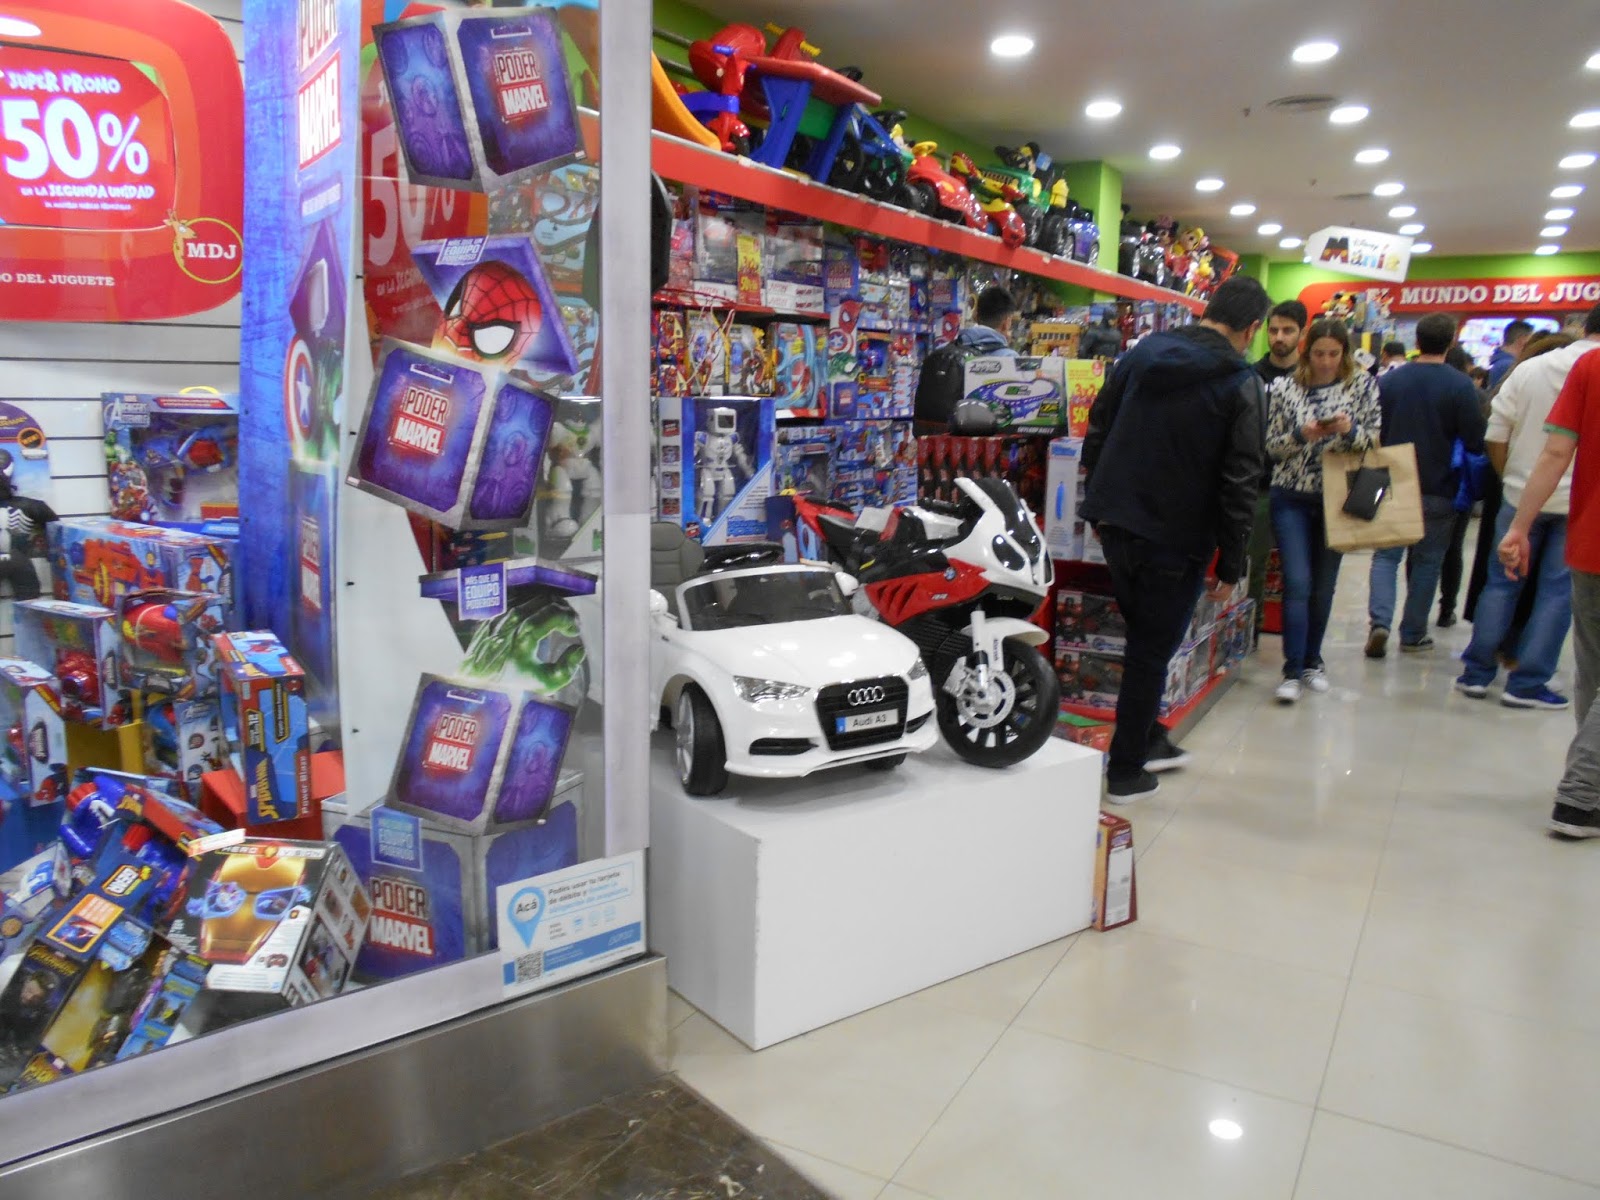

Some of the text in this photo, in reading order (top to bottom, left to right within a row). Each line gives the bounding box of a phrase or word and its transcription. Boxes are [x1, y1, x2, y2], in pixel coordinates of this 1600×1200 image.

[496, 52, 539, 83] PODER
[8, 70, 121, 94] SUPER PROMO
[299, 58, 341, 165] MARVEL
[502, 84, 547, 115] MARVEL
[2, 98, 149, 180] 50%
[35, 187, 48, 197] LA
[48, 184, 108, 198] SEGUNDA
[108, 185, 155, 199] UNIDAD
[187, 243, 236, 260] MDJ
[445, 245, 480, 255] EQUIPO
[0, 273, 115, 286] O DEL JUGUETE
[1400, 285, 1487, 304] MUNDO
[1492, 283, 1545, 303] DEL
[1549, 282, 1600, 302] JUG
[404, 388, 448, 424] PODER
[394, 416, 442, 454] MARVEL
[465, 582, 500, 599] EQUIPO
[439, 715, 477, 744] PODER
[852, 714, 887, 727] Audi A3
[428, 742, 470, 770] MARVEL
[371, 879, 427, 918] PODER
[516, 898, 537, 914] Acá
[370, 915, 433, 955] MARVEL
